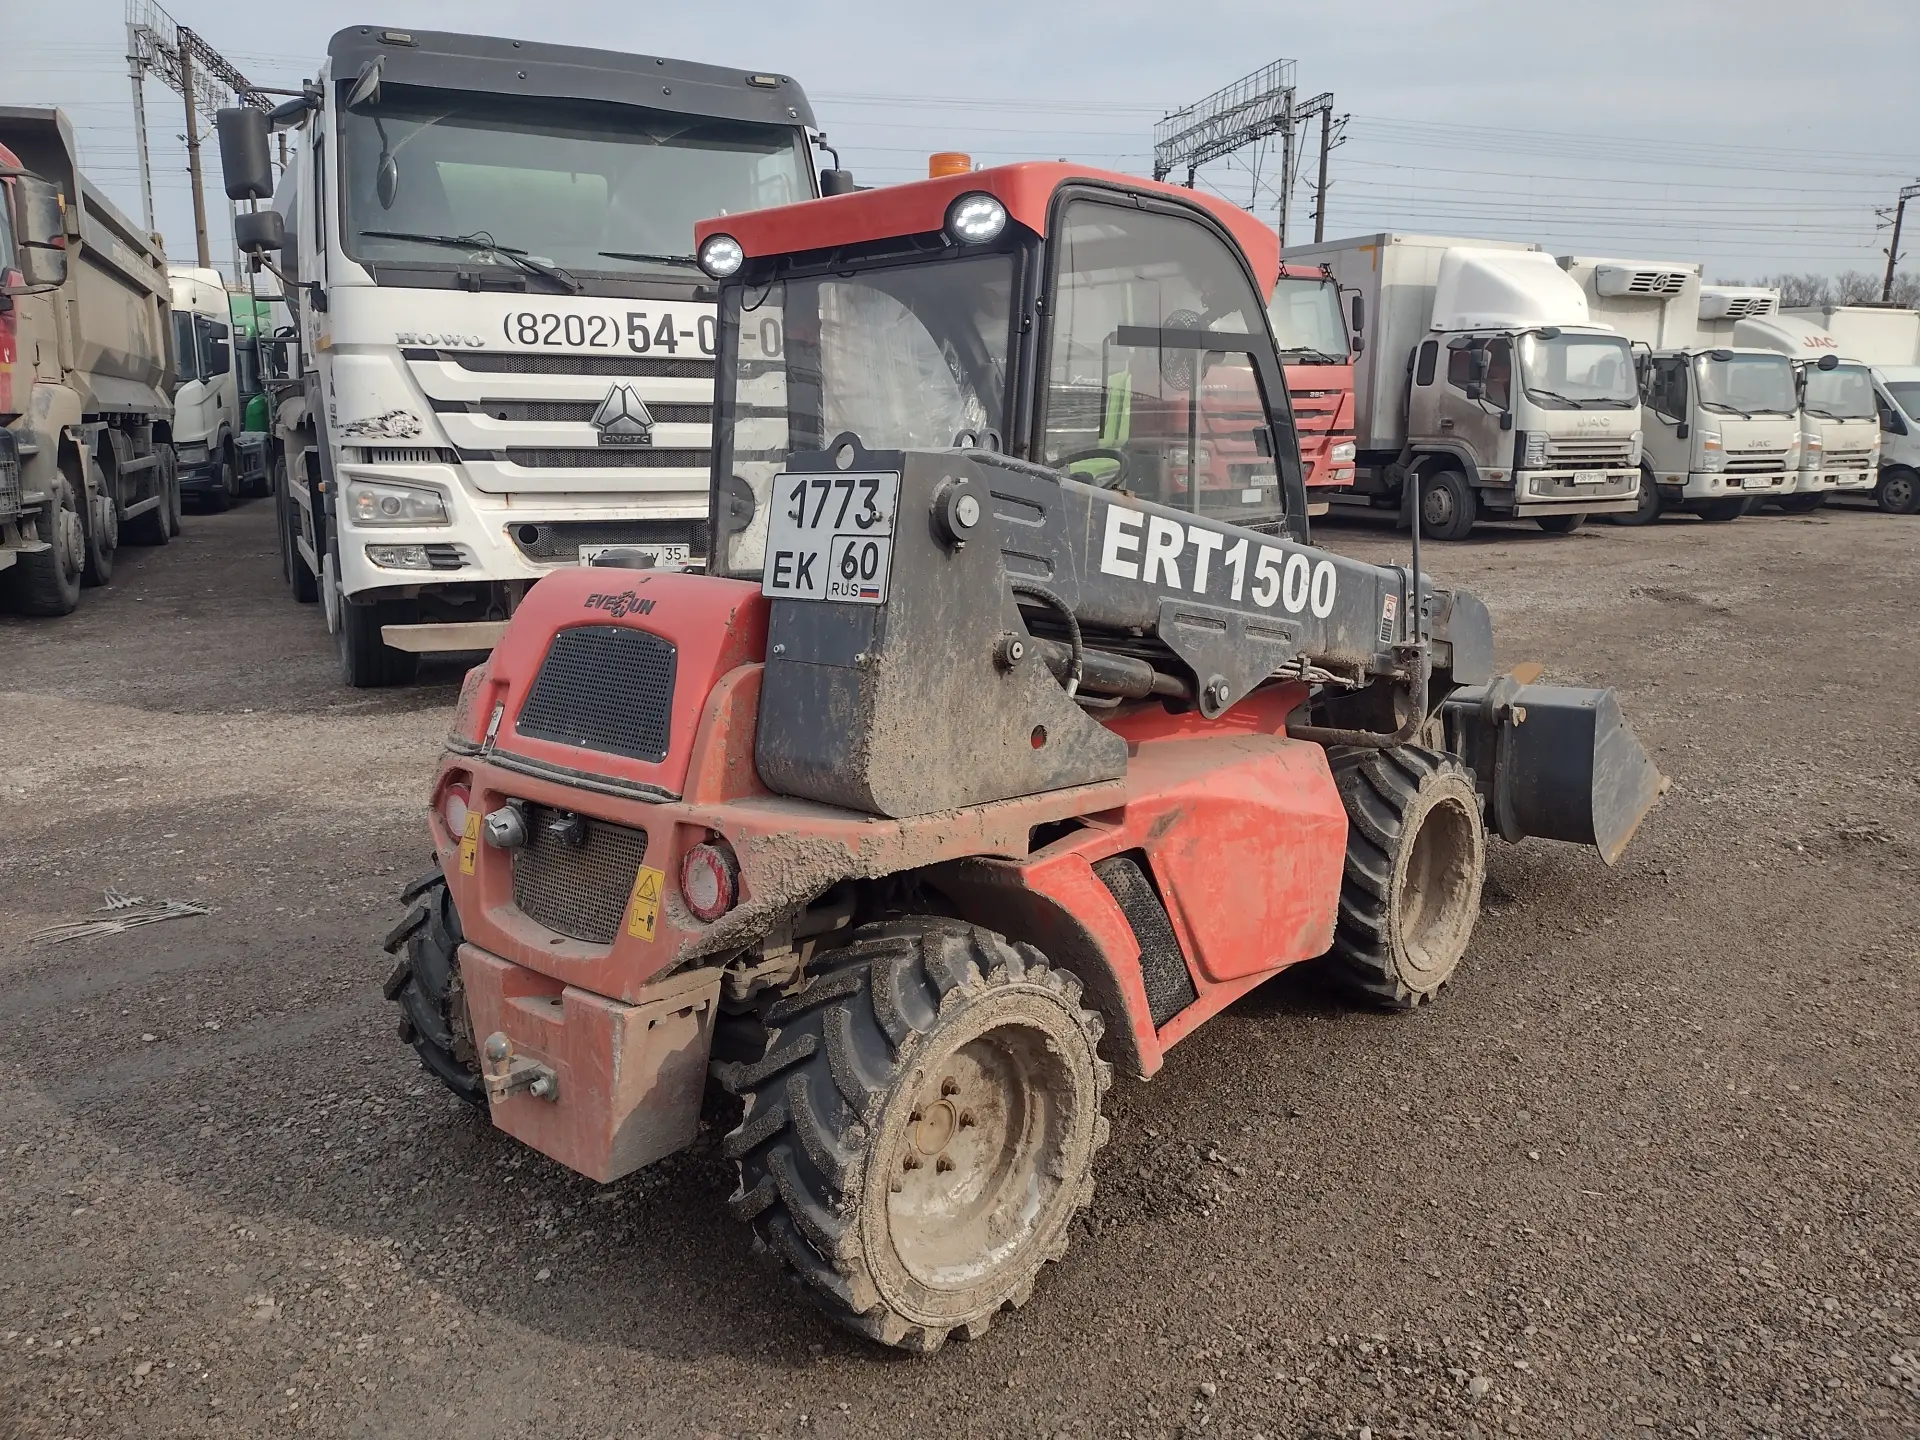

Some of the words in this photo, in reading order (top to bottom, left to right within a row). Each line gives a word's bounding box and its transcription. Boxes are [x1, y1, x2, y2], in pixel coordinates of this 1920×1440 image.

[504, 311, 620, 348] (8202)
[395, 331, 486, 348] HOWO
[1803, 335, 1838, 348] JAC
[1577, 415, 1611, 427] JAC
[602, 435, 649, 443] CNHTC
[1748, 440, 1772, 448] JAC
[789, 479, 880, 530] 1773
[665, 547, 682, 561] 35
[840, 540, 879, 581] 60
[1100, 503, 1338, 619] ERT1500
[772, 550, 818, 591] EK
[831, 582, 859, 597] RUS
